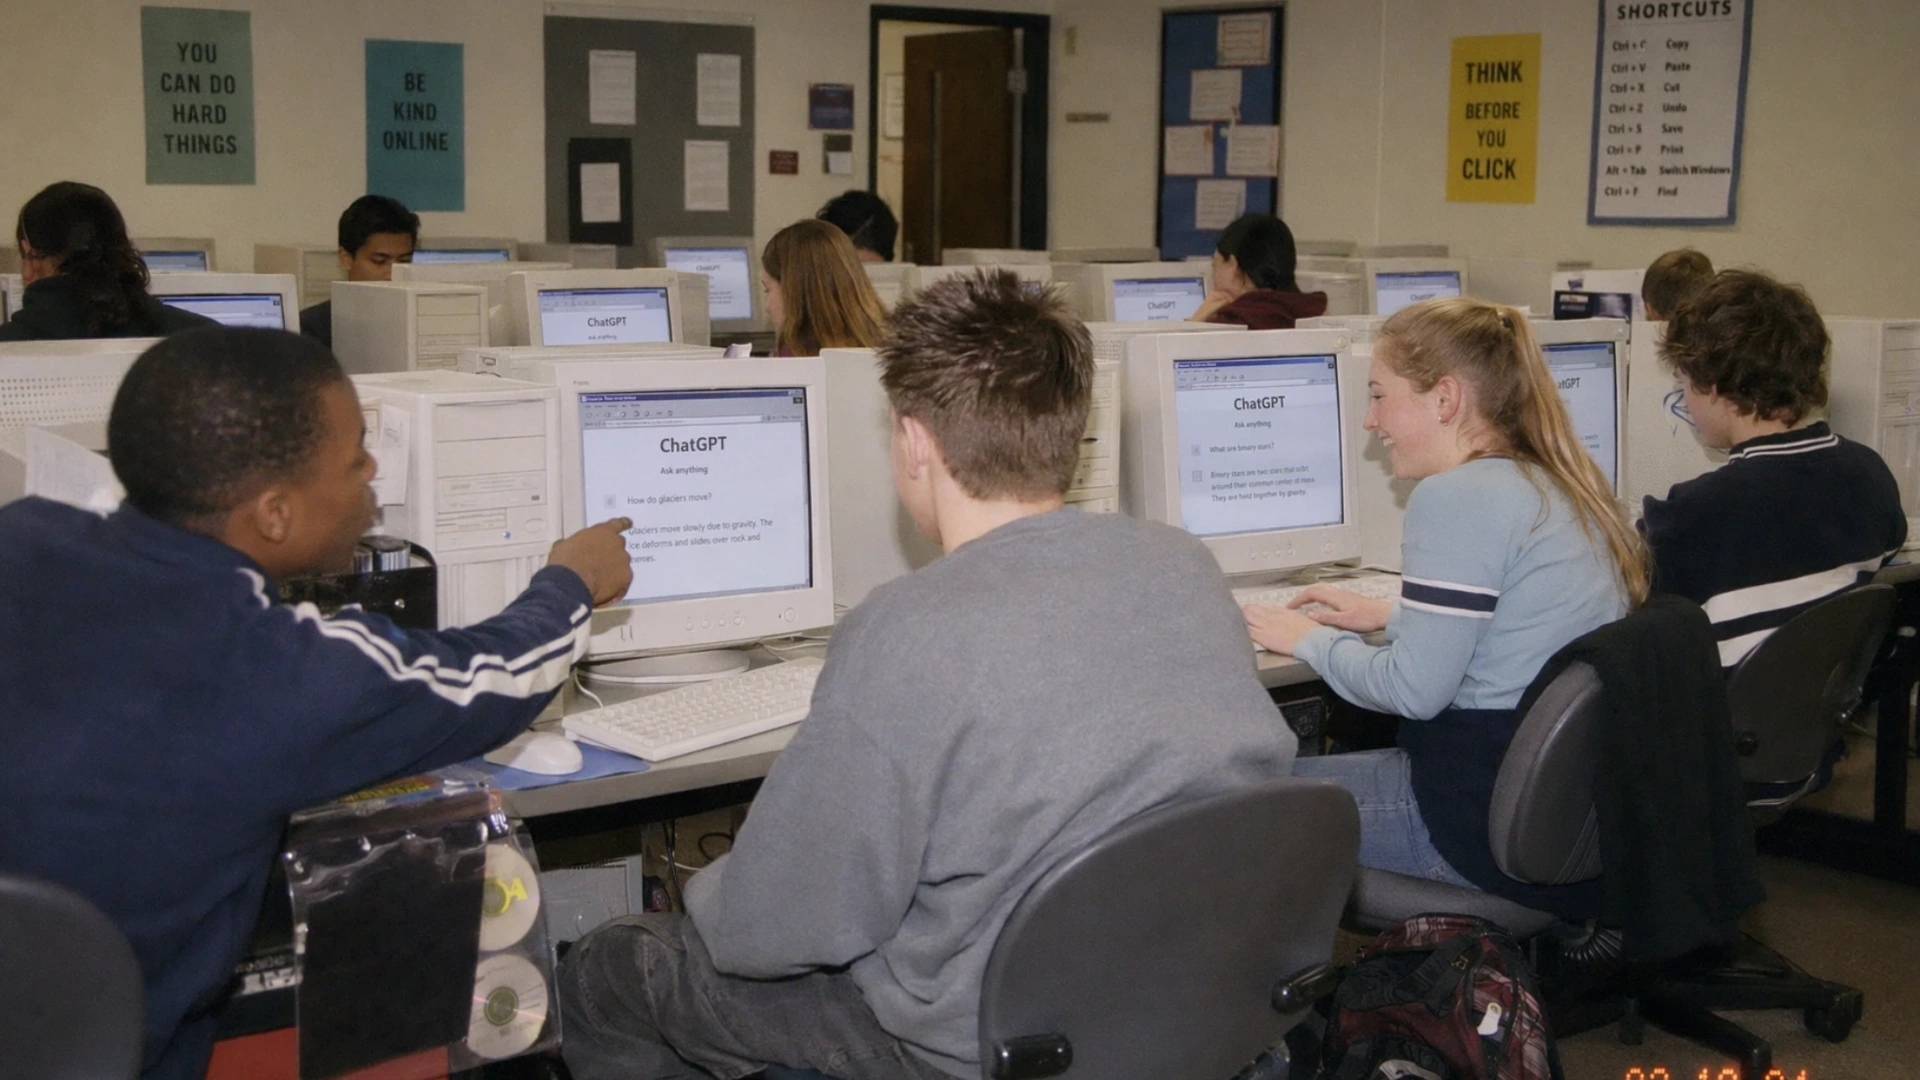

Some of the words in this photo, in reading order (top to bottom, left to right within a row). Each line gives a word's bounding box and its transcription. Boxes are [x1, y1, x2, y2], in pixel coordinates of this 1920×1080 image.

[1617, 0, 1731, 20] SHORTCUTS
[1612, 40, 1629, 51] Ctrl
[1666, 38, 1689, 50] Copy
[177, 43, 217, 63] YOU
[1466, 61, 1522, 83] THINK
[1611, 63, 1628, 73] Ctrl
[1639, 62, 1646, 72] V
[1665, 61, 1690, 71] Paste
[161, 73, 200, 93] CAN
[210, 74, 235, 94] DO
[405, 73, 425, 92] BE
[1610, 83, 1627, 93] Ctrl
[1639, 82, 1644, 92] X
[1664, 82, 1680, 92] Cut
[173, 104, 226, 124] HARD
[394, 102, 436, 121] KIND
[1466, 102, 1520, 119] BEFORE
[1609, 103, 1626, 113] Ctrl
[1663, 102, 1687, 112] Undo
[1608, 123, 1624, 134] Ctrl
[1662, 123, 1683, 133] Save
[164, 134, 237, 154] THINGS
[383, 131, 448, 151] ONLINE
[1477, 129, 1506, 148] YOU
[1607, 144, 1624, 154] Ctrl
[1661, 144, 1684, 153] Print
[1463, 158, 1515, 180] CLICK
[1606, 165, 1619, 175] Alt
[1631, 165, 1646, 175] Tab
[1660, 165, 1688, 175] Switch
[1690, 165, 1730, 175] Windows
[1604, 185, 1622, 196] Ctrl
[1658, 186, 1678, 196] Find
[588, 316, 627, 328] ChatGPT
[1557, 376, 1582, 390] atGPT
[1234, 396, 1285, 410] ChatGPT
[660, 436, 727, 452] ChatGPT
[1210, 445, 1226, 453] What
[1238, 444, 1257, 452] binary
[661, 466, 674, 475] Ask
[676, 465, 709, 476] anything
[628, 496, 646, 505] How
[647, 495, 658, 505] do
[658, 494, 687, 506] glaciers
[689, 492, 713, 502] move?
[660, 525, 682, 533] move
[683, 523, 706, 533] slowly
[707, 522, 722, 531] due
[722, 521, 732, 530] to
[760, 518, 774, 527] The
[642, 539, 674, 550] deforms
[675, 537, 689, 547] and
[690, 536, 712, 546] slides
[712, 536, 729, 545] over
[731, 533, 747, 543] rock
[748, 532, 761, 542] and
